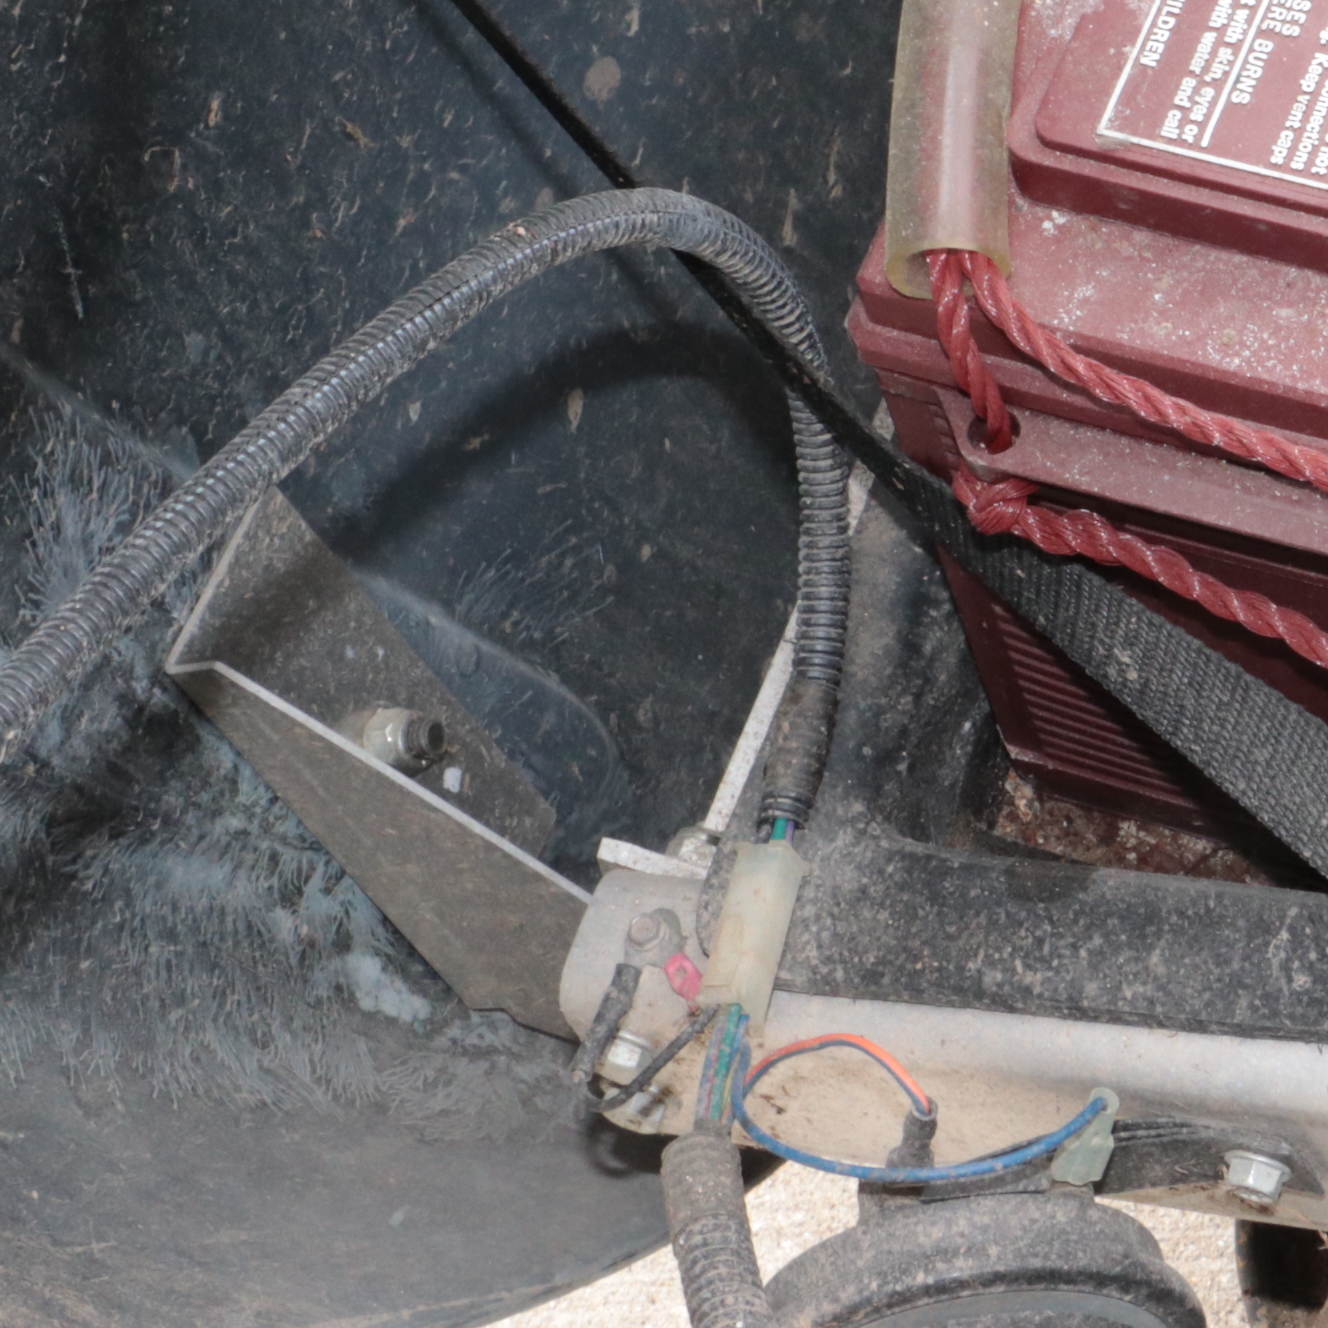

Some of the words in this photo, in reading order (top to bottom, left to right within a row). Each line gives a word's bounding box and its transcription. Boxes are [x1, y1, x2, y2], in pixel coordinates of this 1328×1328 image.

[1224, 9, 1249, 43] with
[1189, 32, 1218, 74] water
[1203, 47, 1234, 82] skin,
[1230, 39, 1274, 104] BURNS
[1174, 77, 1197, 108] and
[1189, 87, 1215, 122] eyes
[1160, 109, 1182, 139] call
[1285, 95, 1310, 129] vent
[1181, 124, 1198, 143] or
[1270, 130, 1294, 165] caps
